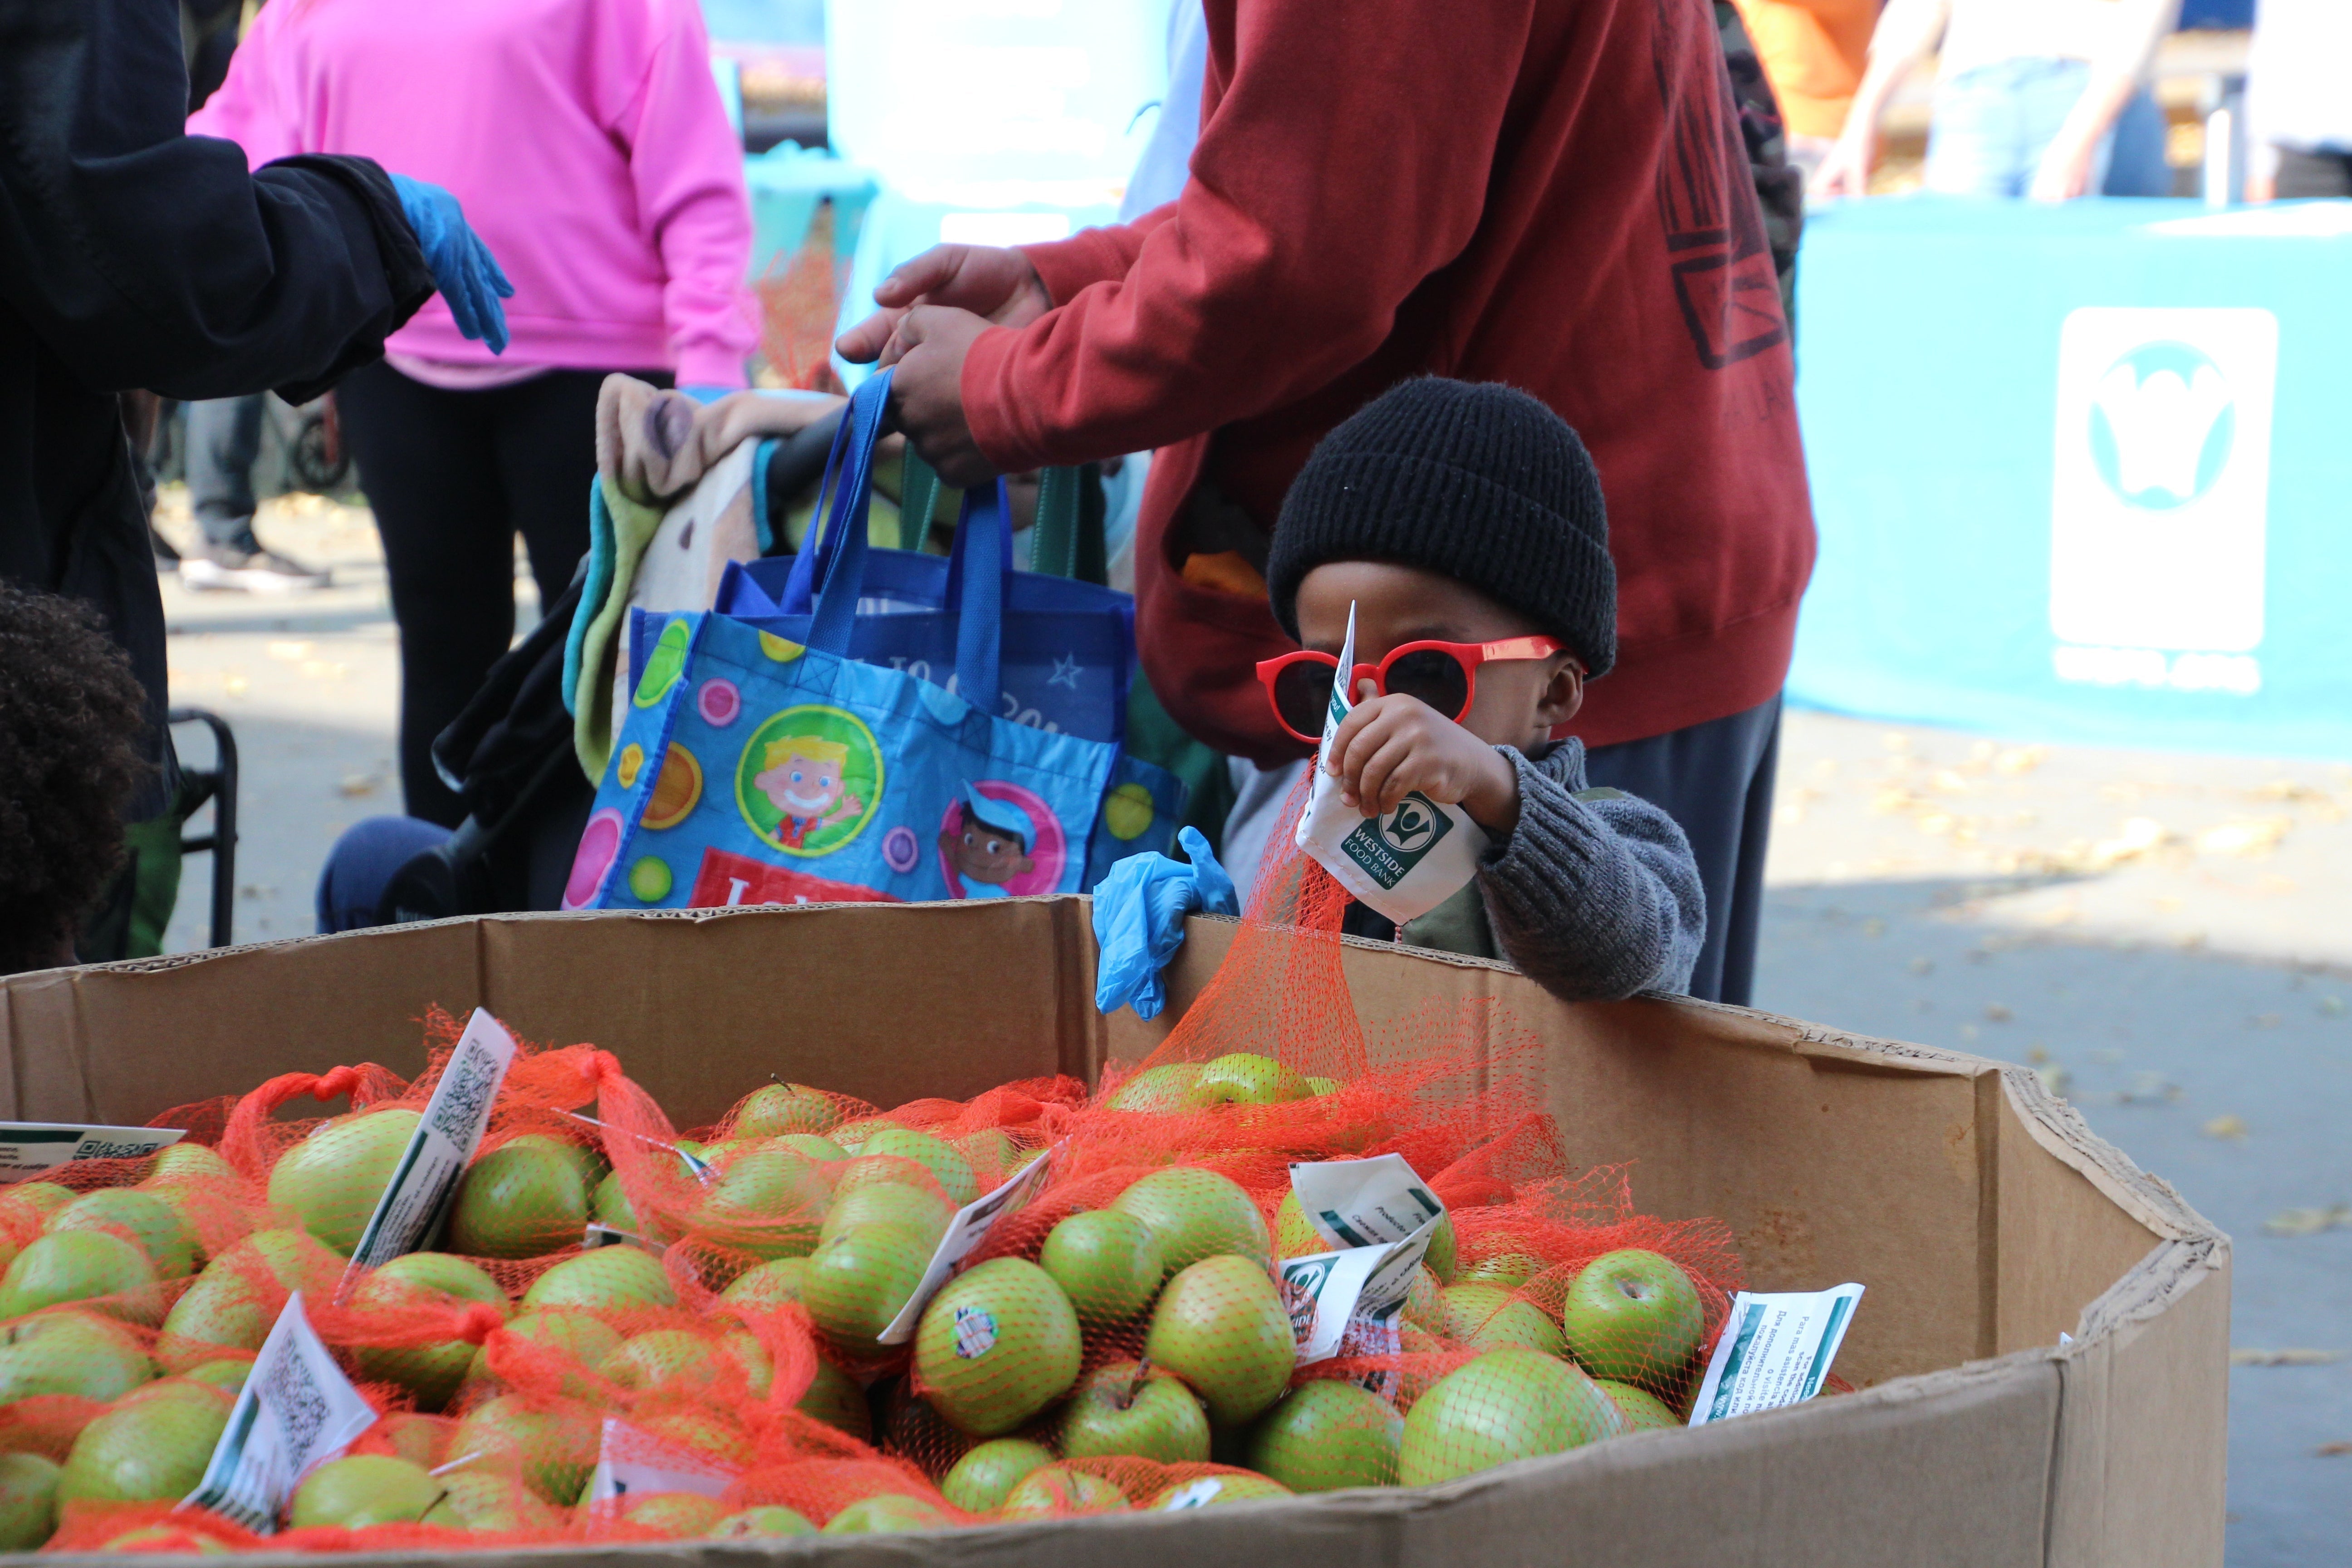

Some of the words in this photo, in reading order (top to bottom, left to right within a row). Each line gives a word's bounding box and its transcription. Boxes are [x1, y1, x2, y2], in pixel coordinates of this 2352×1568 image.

[1330, 696, 1341, 712] you!
[1326, 730, 1333, 741] By
[1355, 828, 1405, 877] WESTSIDE
[1345, 838, 1372, 864] FOOD
[1371, 863, 1396, 886] BANK
[1774, 1310, 1787, 1326] Для
[1796, 1316, 1809, 1335] Para
[1742, 1325, 1767, 1375] пожалуйста
[1788, 1337, 1799, 1354] mas
[1793, 1352, 1804, 1371] scan
[1802, 1356, 1812, 1370] For
[1735, 1377, 1747, 1394] код
[1771, 1356, 1792, 1399] asistencia
[1787, 1373, 1797, 1387] the
[1759, 1375, 1772, 1401] visite
[1731, 1396, 1741, 1414] или
